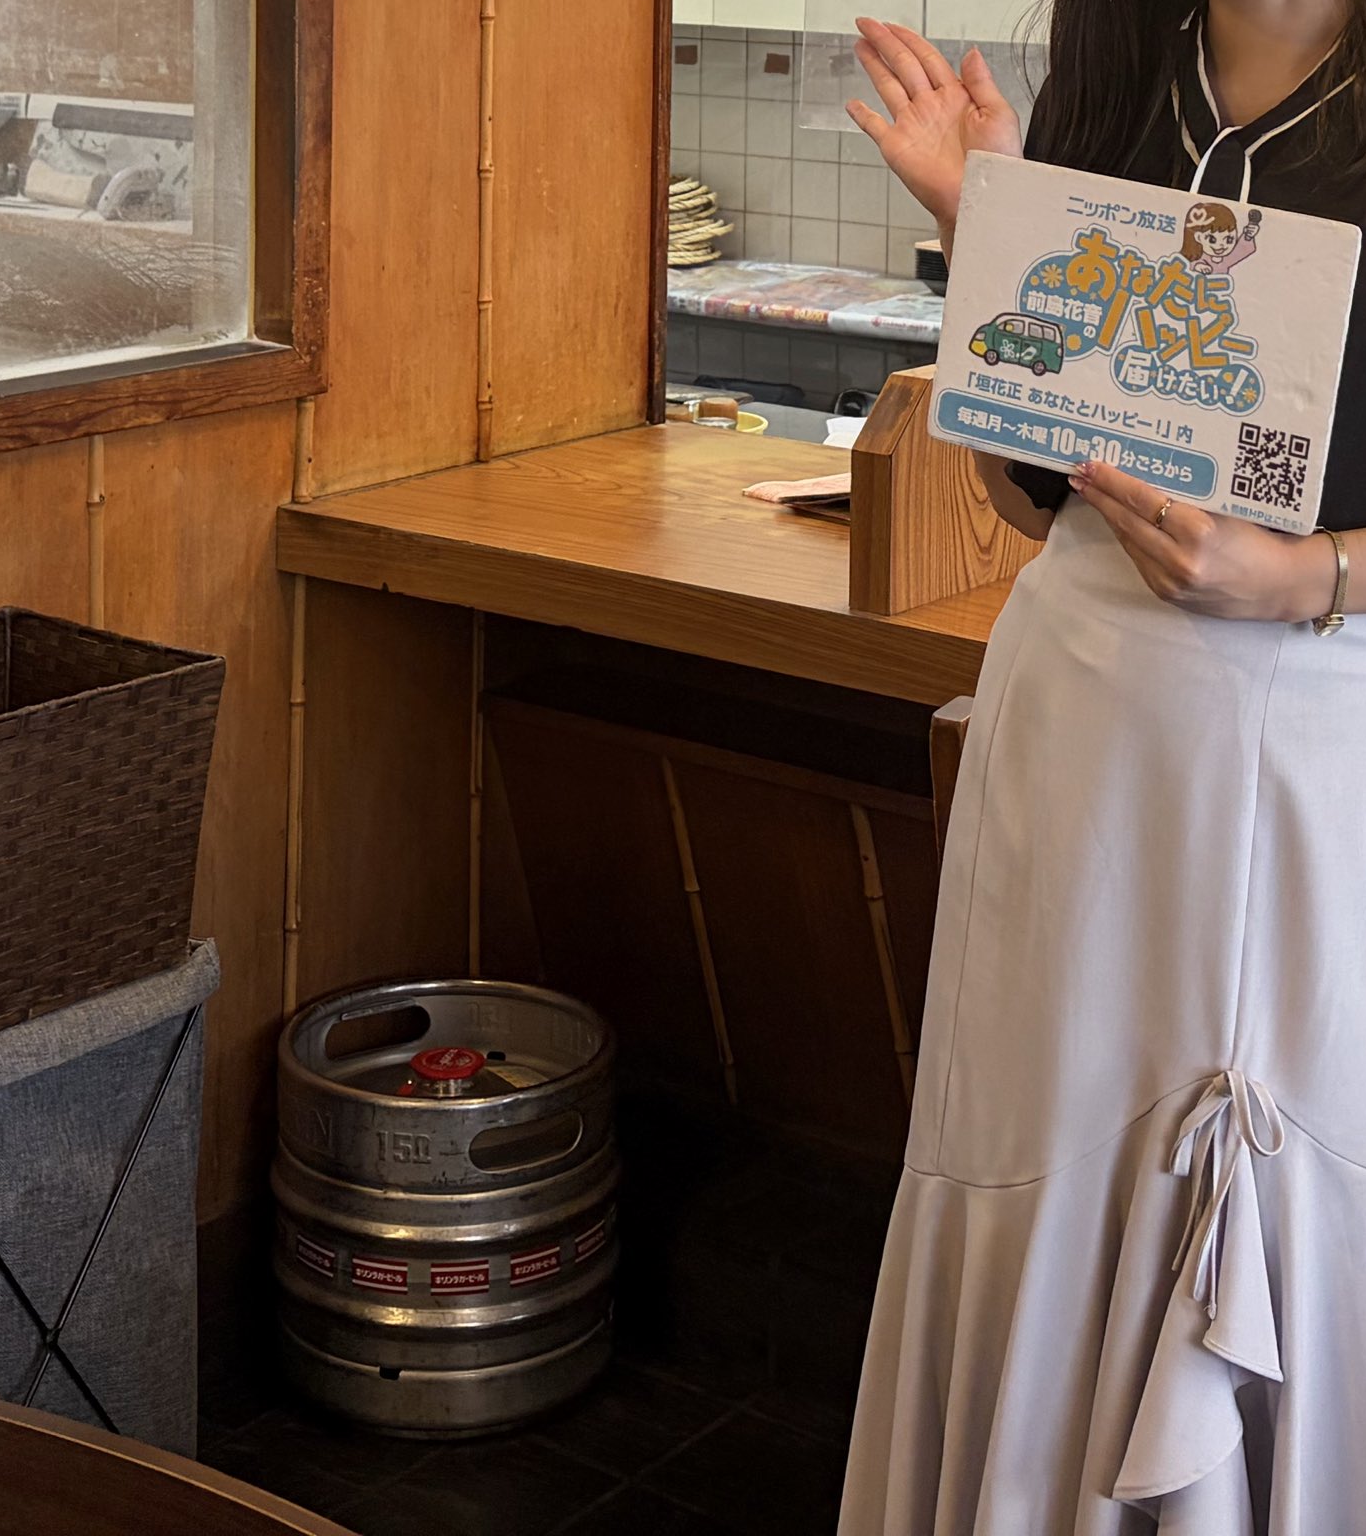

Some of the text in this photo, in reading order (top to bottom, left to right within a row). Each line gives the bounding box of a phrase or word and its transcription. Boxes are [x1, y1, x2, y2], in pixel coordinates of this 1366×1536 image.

[1066, 195, 1177, 235] ニッポン放送
[1065, 230, 1231, 314] あなたに
[1097, 288, 1252, 368] ハッピー
[1118, 349, 1248, 404] 届けたい！
